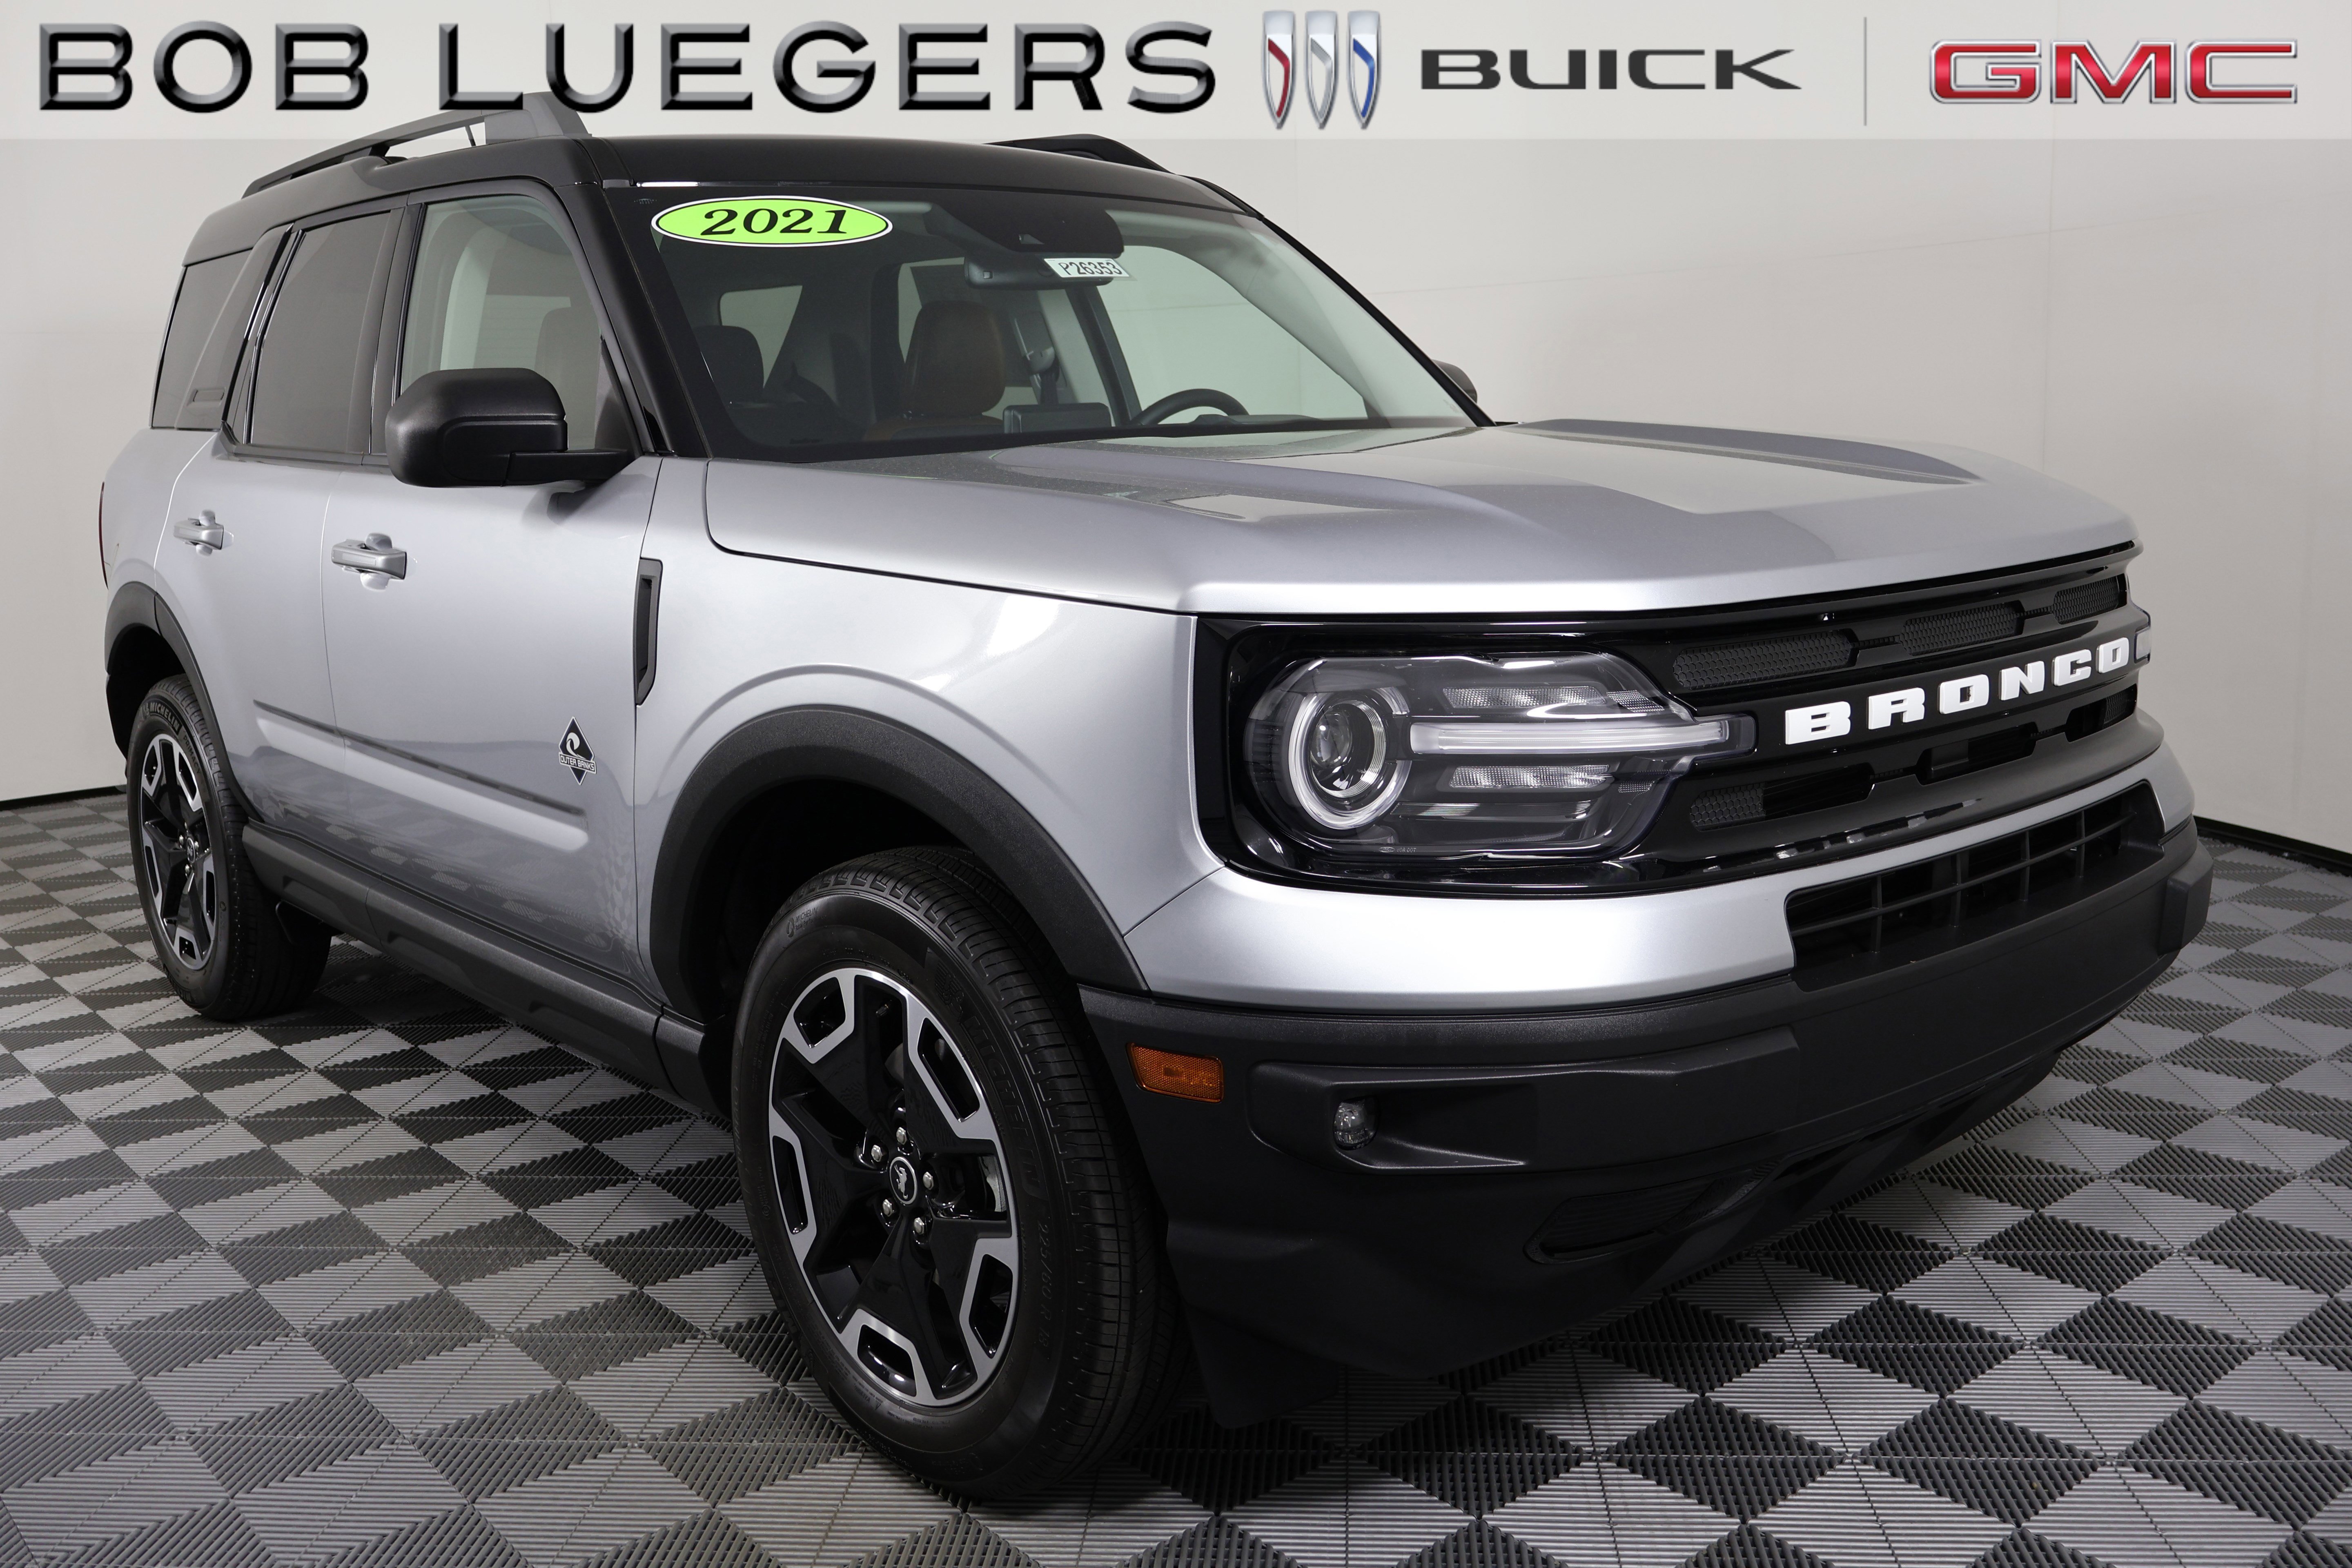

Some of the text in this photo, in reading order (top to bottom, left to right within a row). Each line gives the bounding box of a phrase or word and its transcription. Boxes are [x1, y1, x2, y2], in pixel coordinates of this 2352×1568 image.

[701, 209, 847, 236] 2021
[1058, 261, 1122, 276] P26353
[1785, 637, 2129, 745] BRONCO
[150, 702, 180, 731] MICHELIN
[183, 735, 200, 773] PRIMACY
[560, 755, 595, 771] OUTER BANKS
[1038, 1220, 1052, 1347] 225/60 R 18
